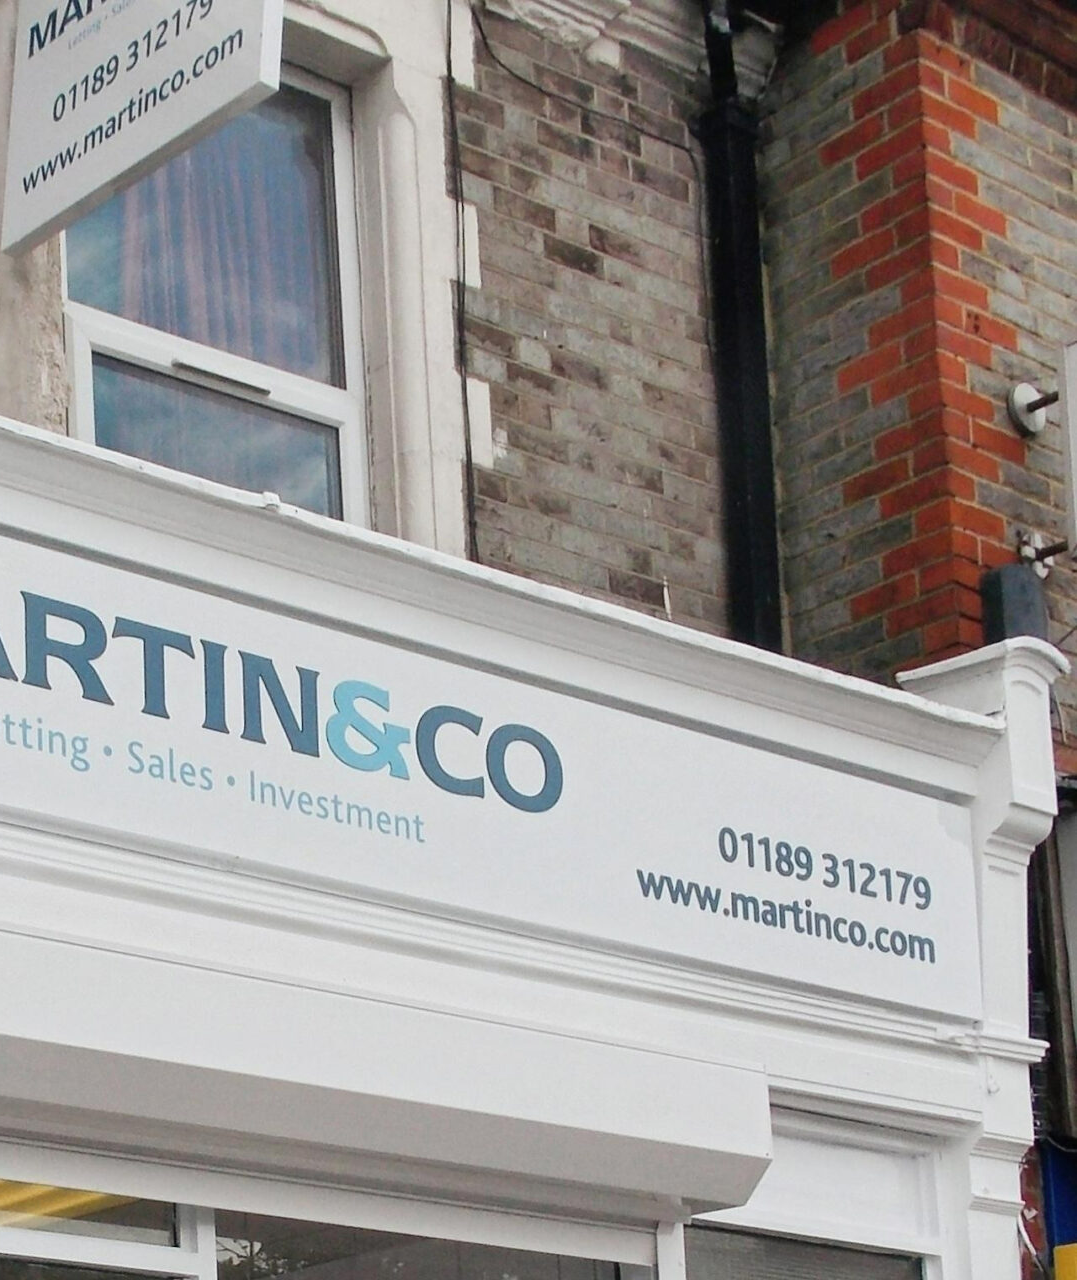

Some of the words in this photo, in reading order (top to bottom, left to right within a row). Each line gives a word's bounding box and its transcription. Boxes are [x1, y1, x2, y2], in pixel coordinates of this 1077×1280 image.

[22, 28, 244, 194] www.martinco.com
[53, 54, 119, 122] 01189
[126, 0, 213, 72] 312179
[128, 741, 214, 791] Sales
[249, 771, 426, 843] Investment
[636, 868, 936, 964] www.martinco.com
[718, 826, 814, 881] 01189
[822, 853, 932, 911] 312179
